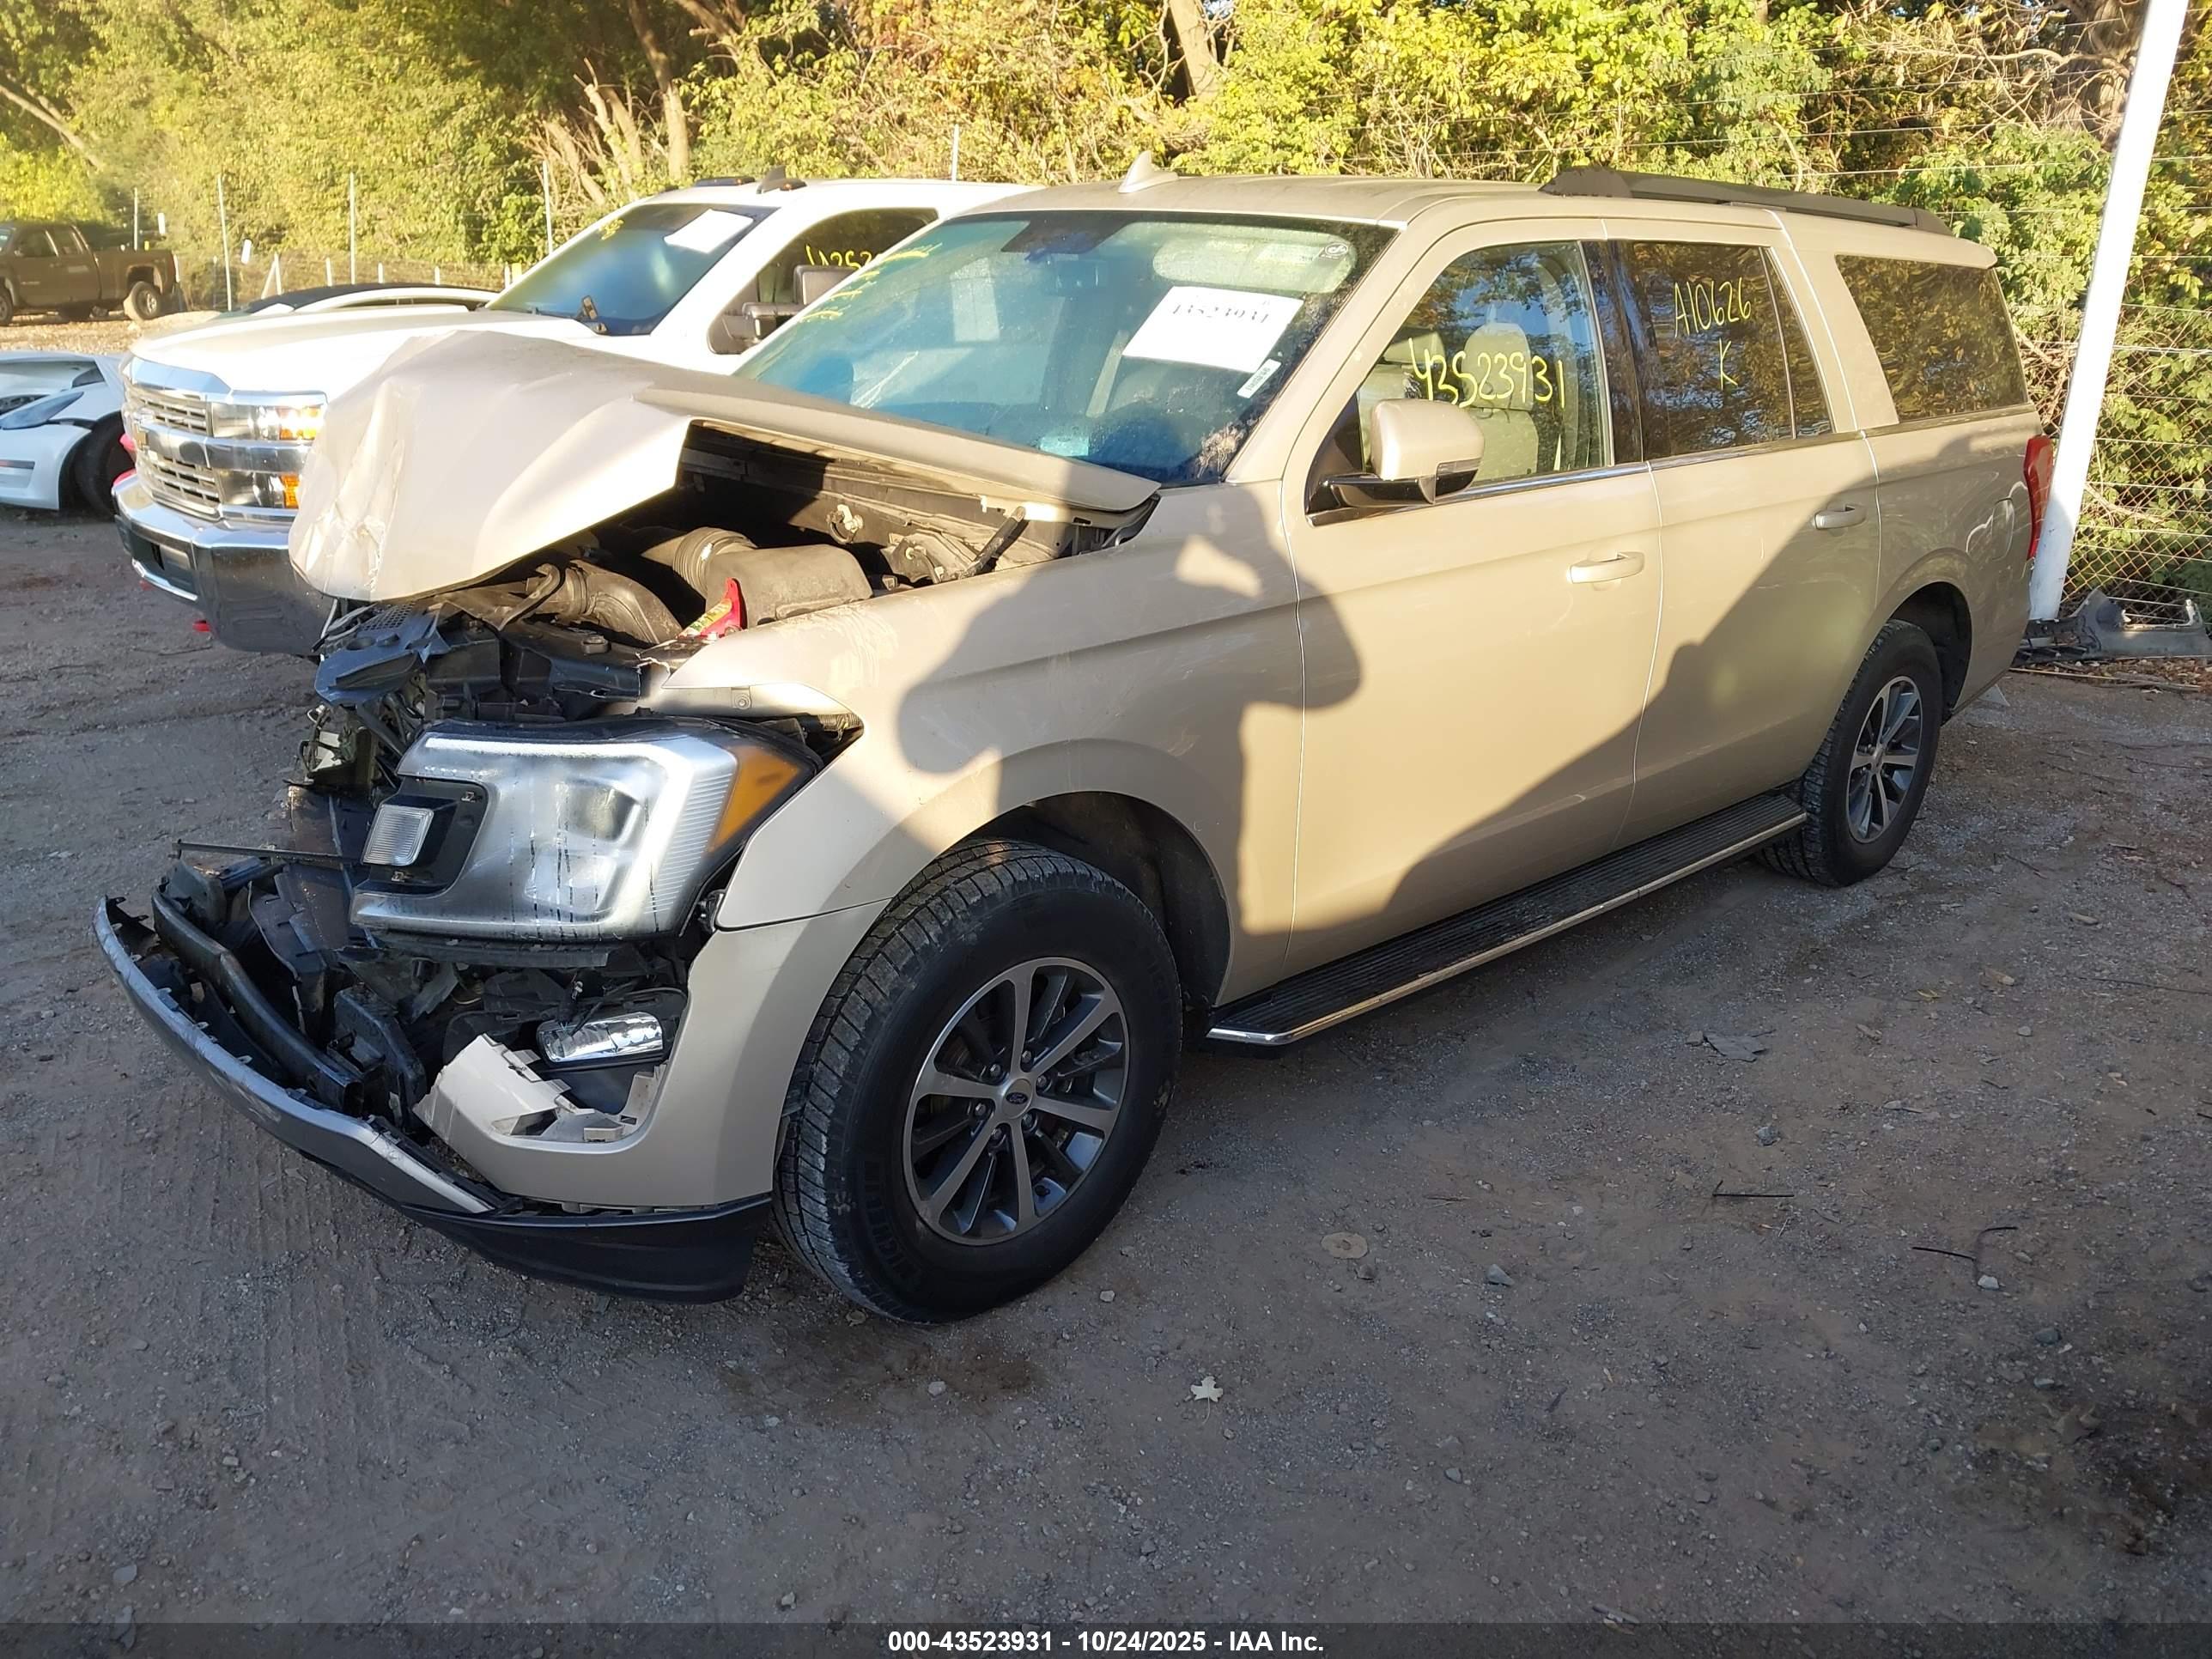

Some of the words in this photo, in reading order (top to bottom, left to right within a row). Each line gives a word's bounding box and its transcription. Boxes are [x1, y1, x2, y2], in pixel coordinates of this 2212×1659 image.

[1674, 276, 1752, 338] A10626
[1408, 337, 1565, 409] 43523931
[1718, 337, 1738, 391] K
